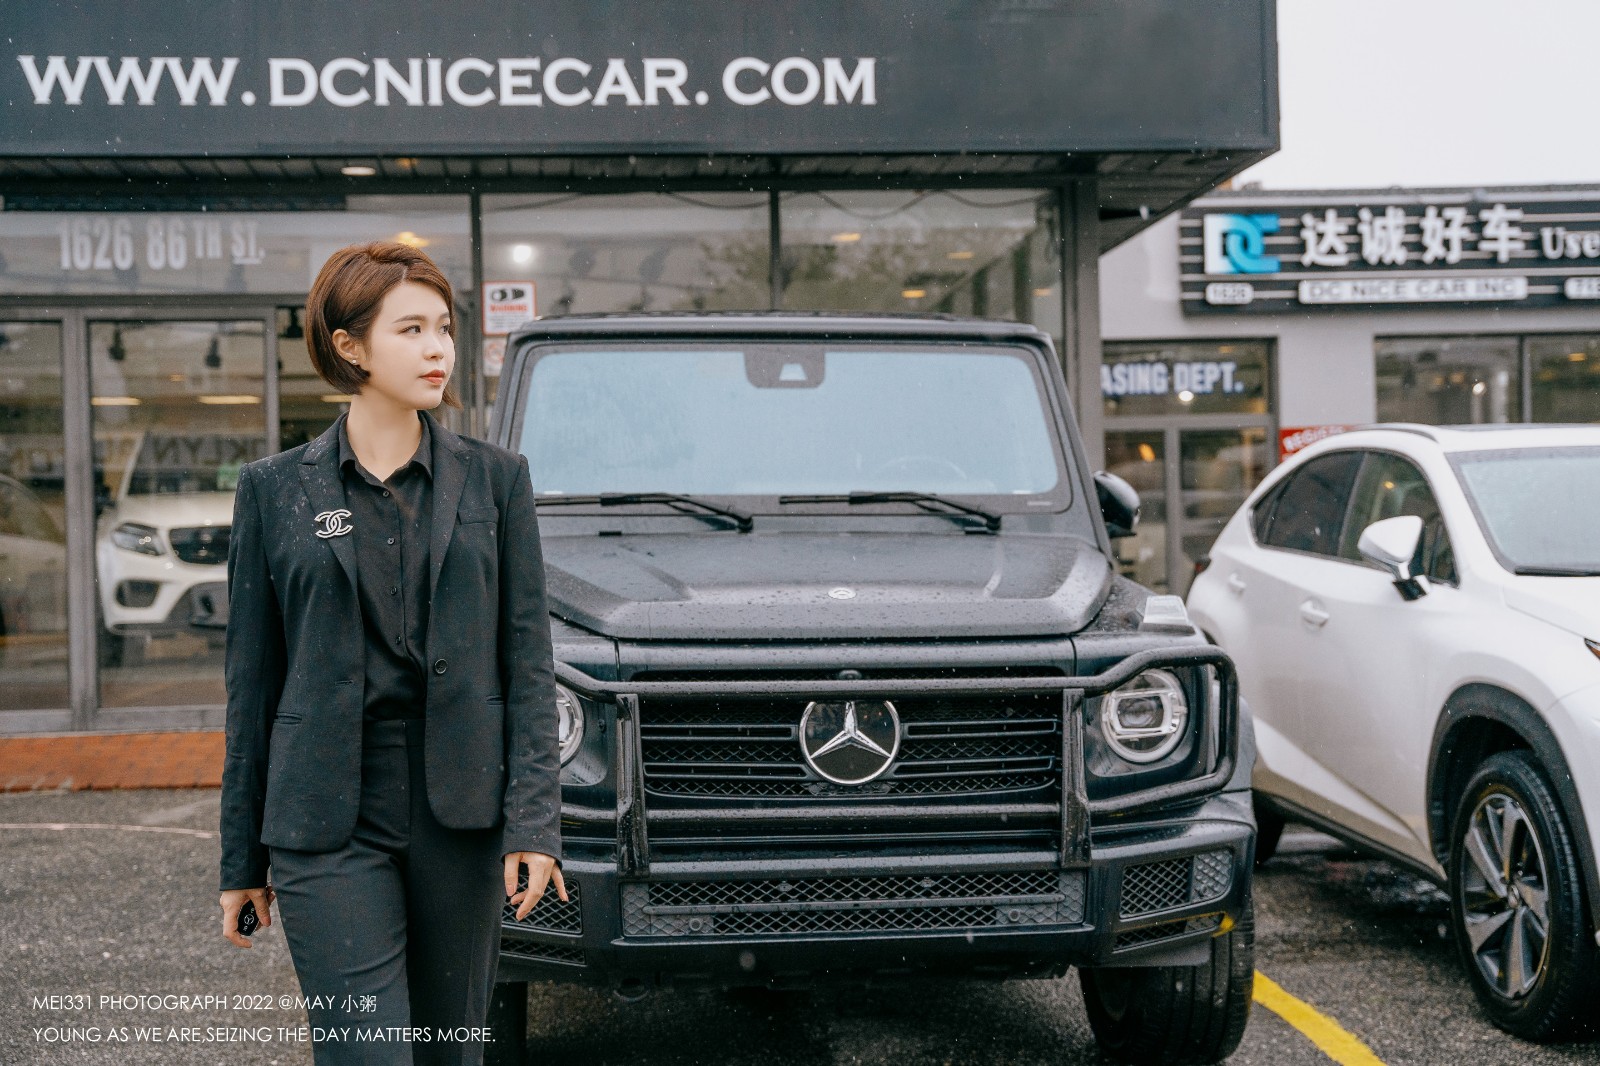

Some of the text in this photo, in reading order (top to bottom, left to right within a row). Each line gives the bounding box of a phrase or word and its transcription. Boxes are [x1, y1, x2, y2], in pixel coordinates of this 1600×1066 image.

[59, 216, 134, 270] 1626
[1301, 203, 1525, 266] 达诚好车
[1310, 278, 1516, 298] DC NICE CAR INC
[1173, 361, 1244, 393] DEPT.
